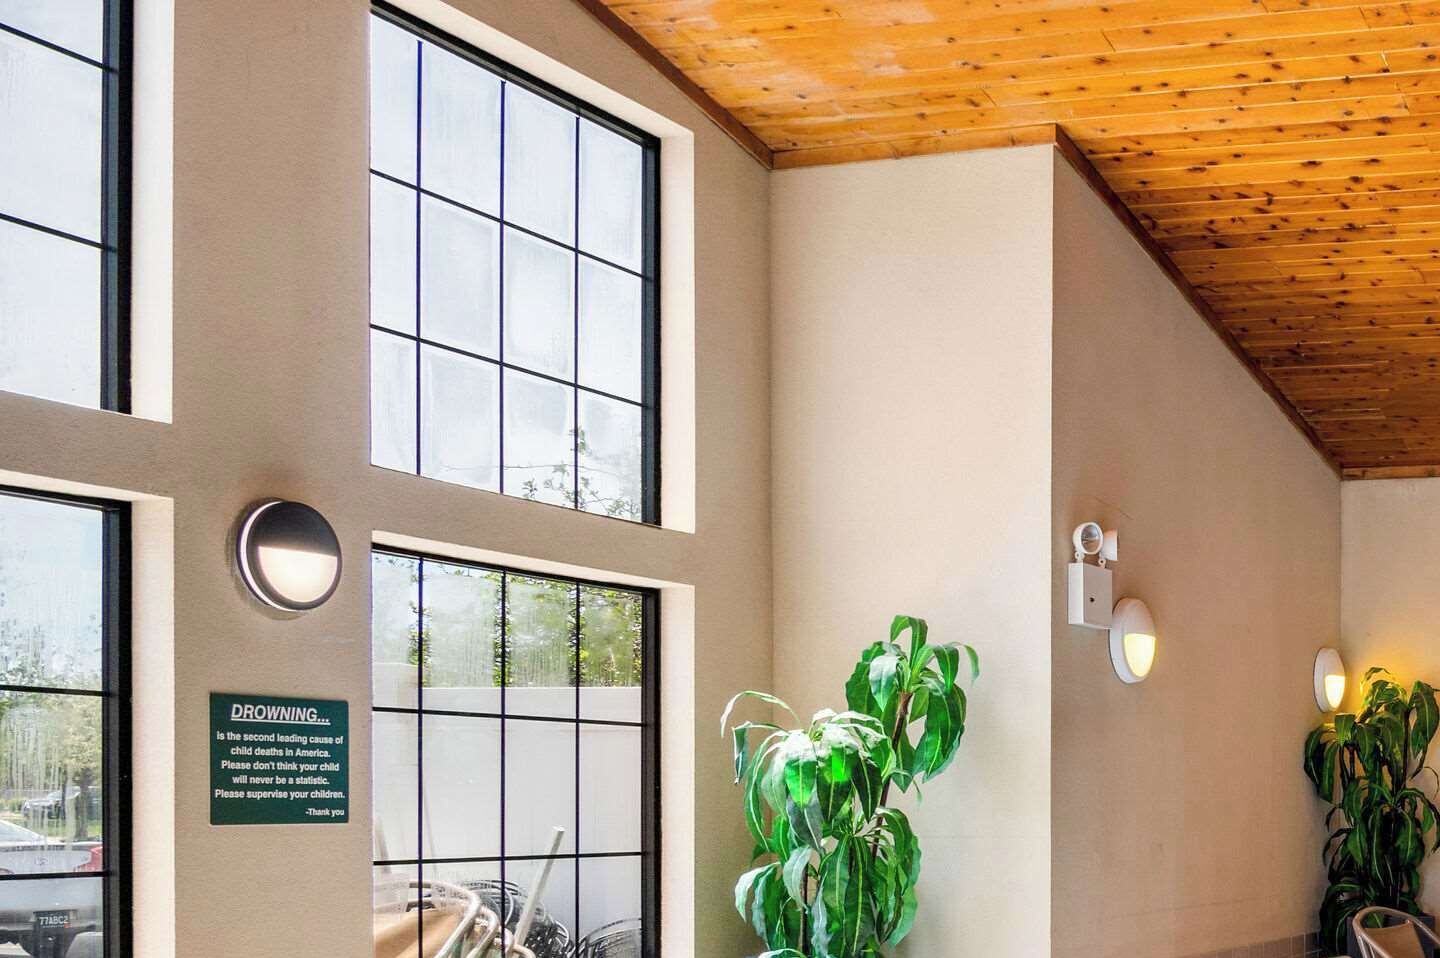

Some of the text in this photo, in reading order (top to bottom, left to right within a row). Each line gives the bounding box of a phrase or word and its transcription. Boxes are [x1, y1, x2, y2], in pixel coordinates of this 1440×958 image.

[231, 704, 330, 724] DROWNING...
[227, 732, 241, 741] the
[243, 733, 275, 742] second
[277, 733, 308, 745] leading
[309, 736, 333, 744] cause
[335, 736, 343, 744] of
[231, 746, 331, 758] child deaths in America.
[221, 760, 340, 773] Please don't think your child
[232, 775, 248, 784] will
[276, 776, 286, 784] be
[296, 776, 330, 785] statistic.
[215, 789, 345, 800] Please supervise your children.
[305, 808, 344, 817] -Thank you
